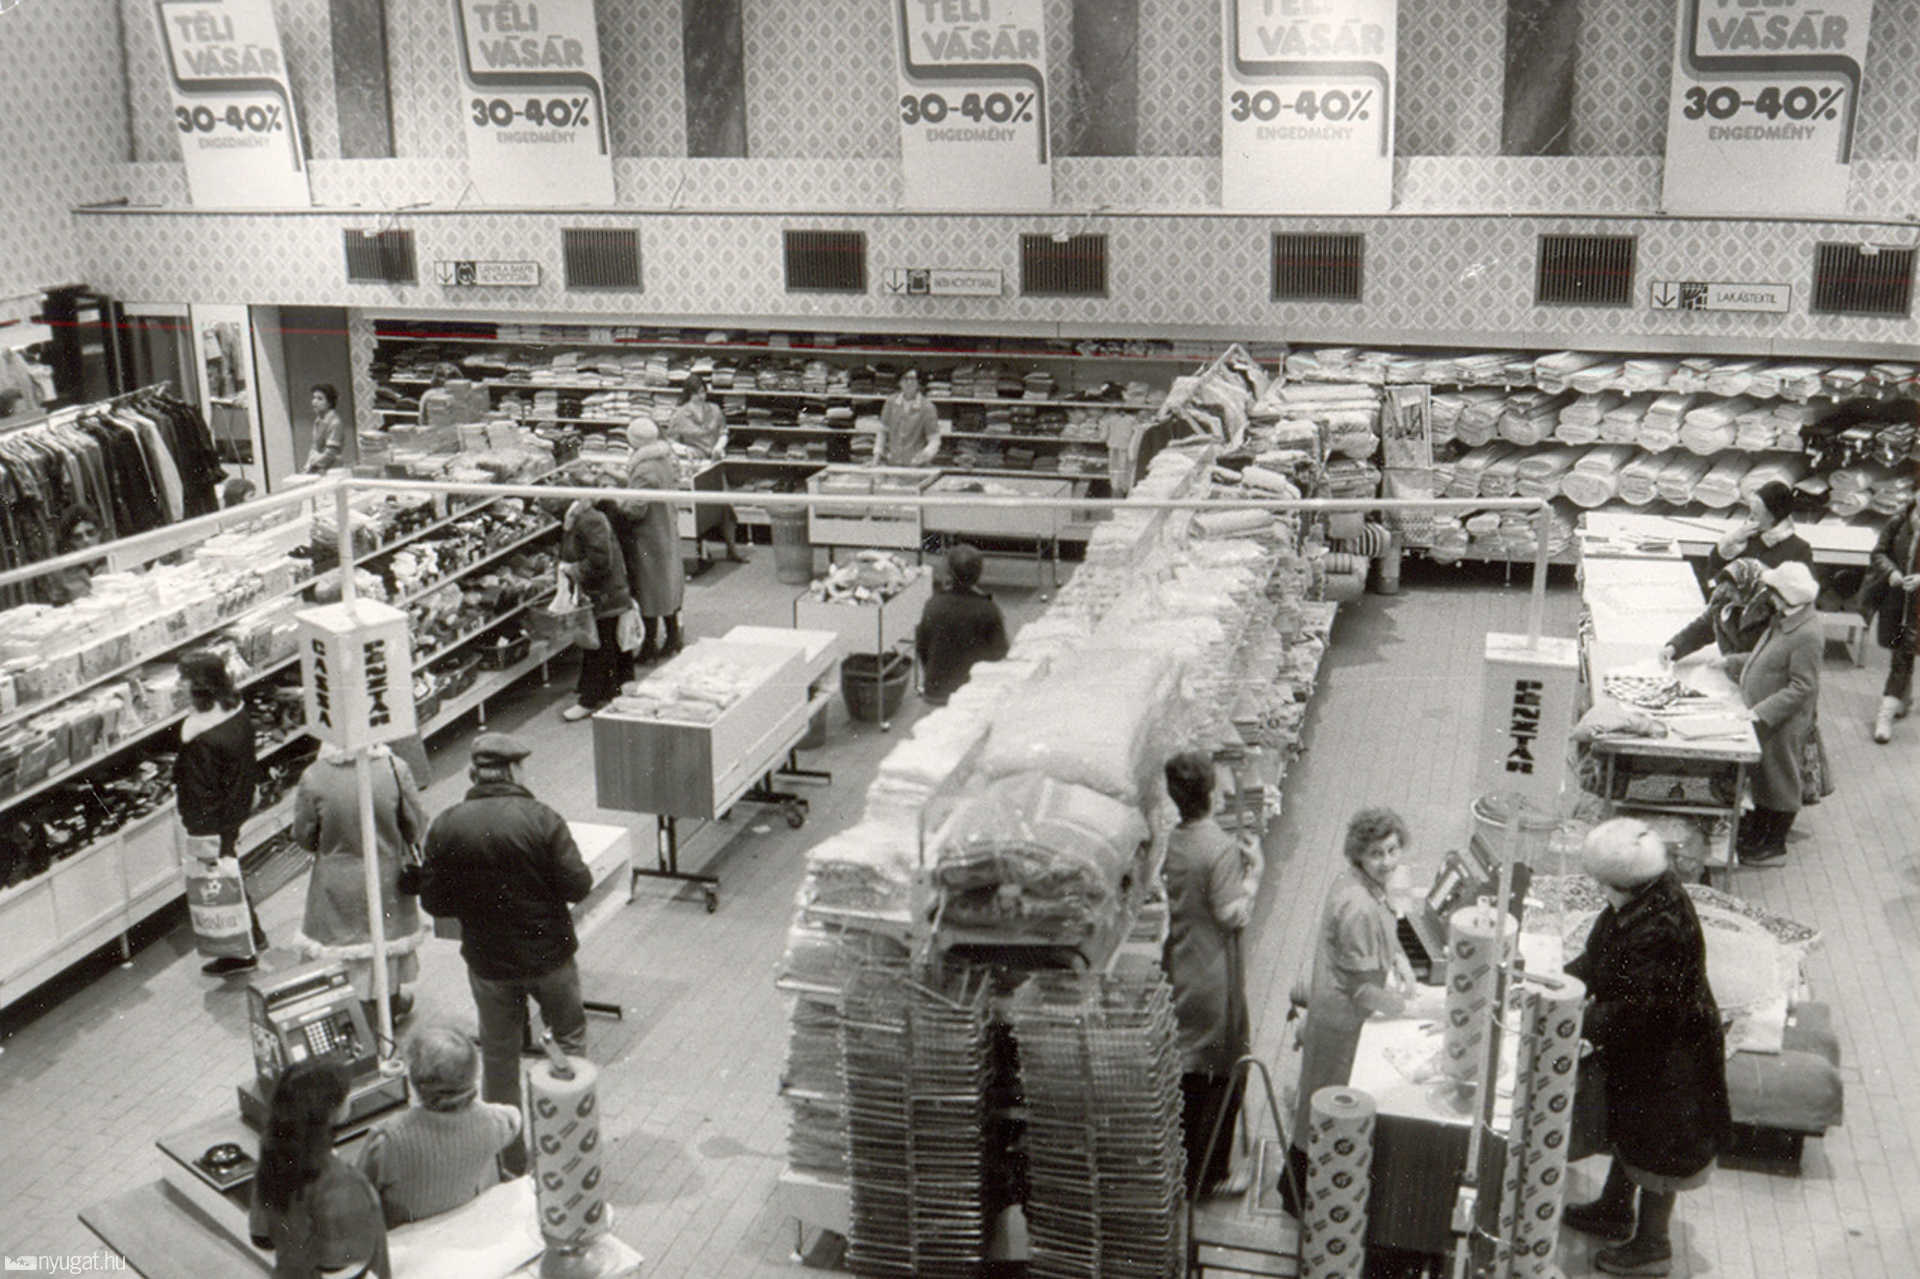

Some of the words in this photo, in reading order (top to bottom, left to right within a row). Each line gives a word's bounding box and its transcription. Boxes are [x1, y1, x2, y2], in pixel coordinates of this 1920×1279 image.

[921, 24, 1040, 60] VÁSÁR
[1257, 18, 1385, 56] VÁSÁR
[1707, 10, 1848, 50] VÁSÁR
[183, 44, 281, 75] VÁSÁR
[478, 34, 585, 68] VÁSÁR
[175, 104, 282, 133] 30-40%
[471, 97, 590, 127] 30-40%
[900, 92, 1035, 125] 30-40%
[1231, 89, 1373, 122] 30-40%
[1683, 85, 1844, 121] 30-40%
[1708, 123, 1815, 141] ENGEDMÉNY
